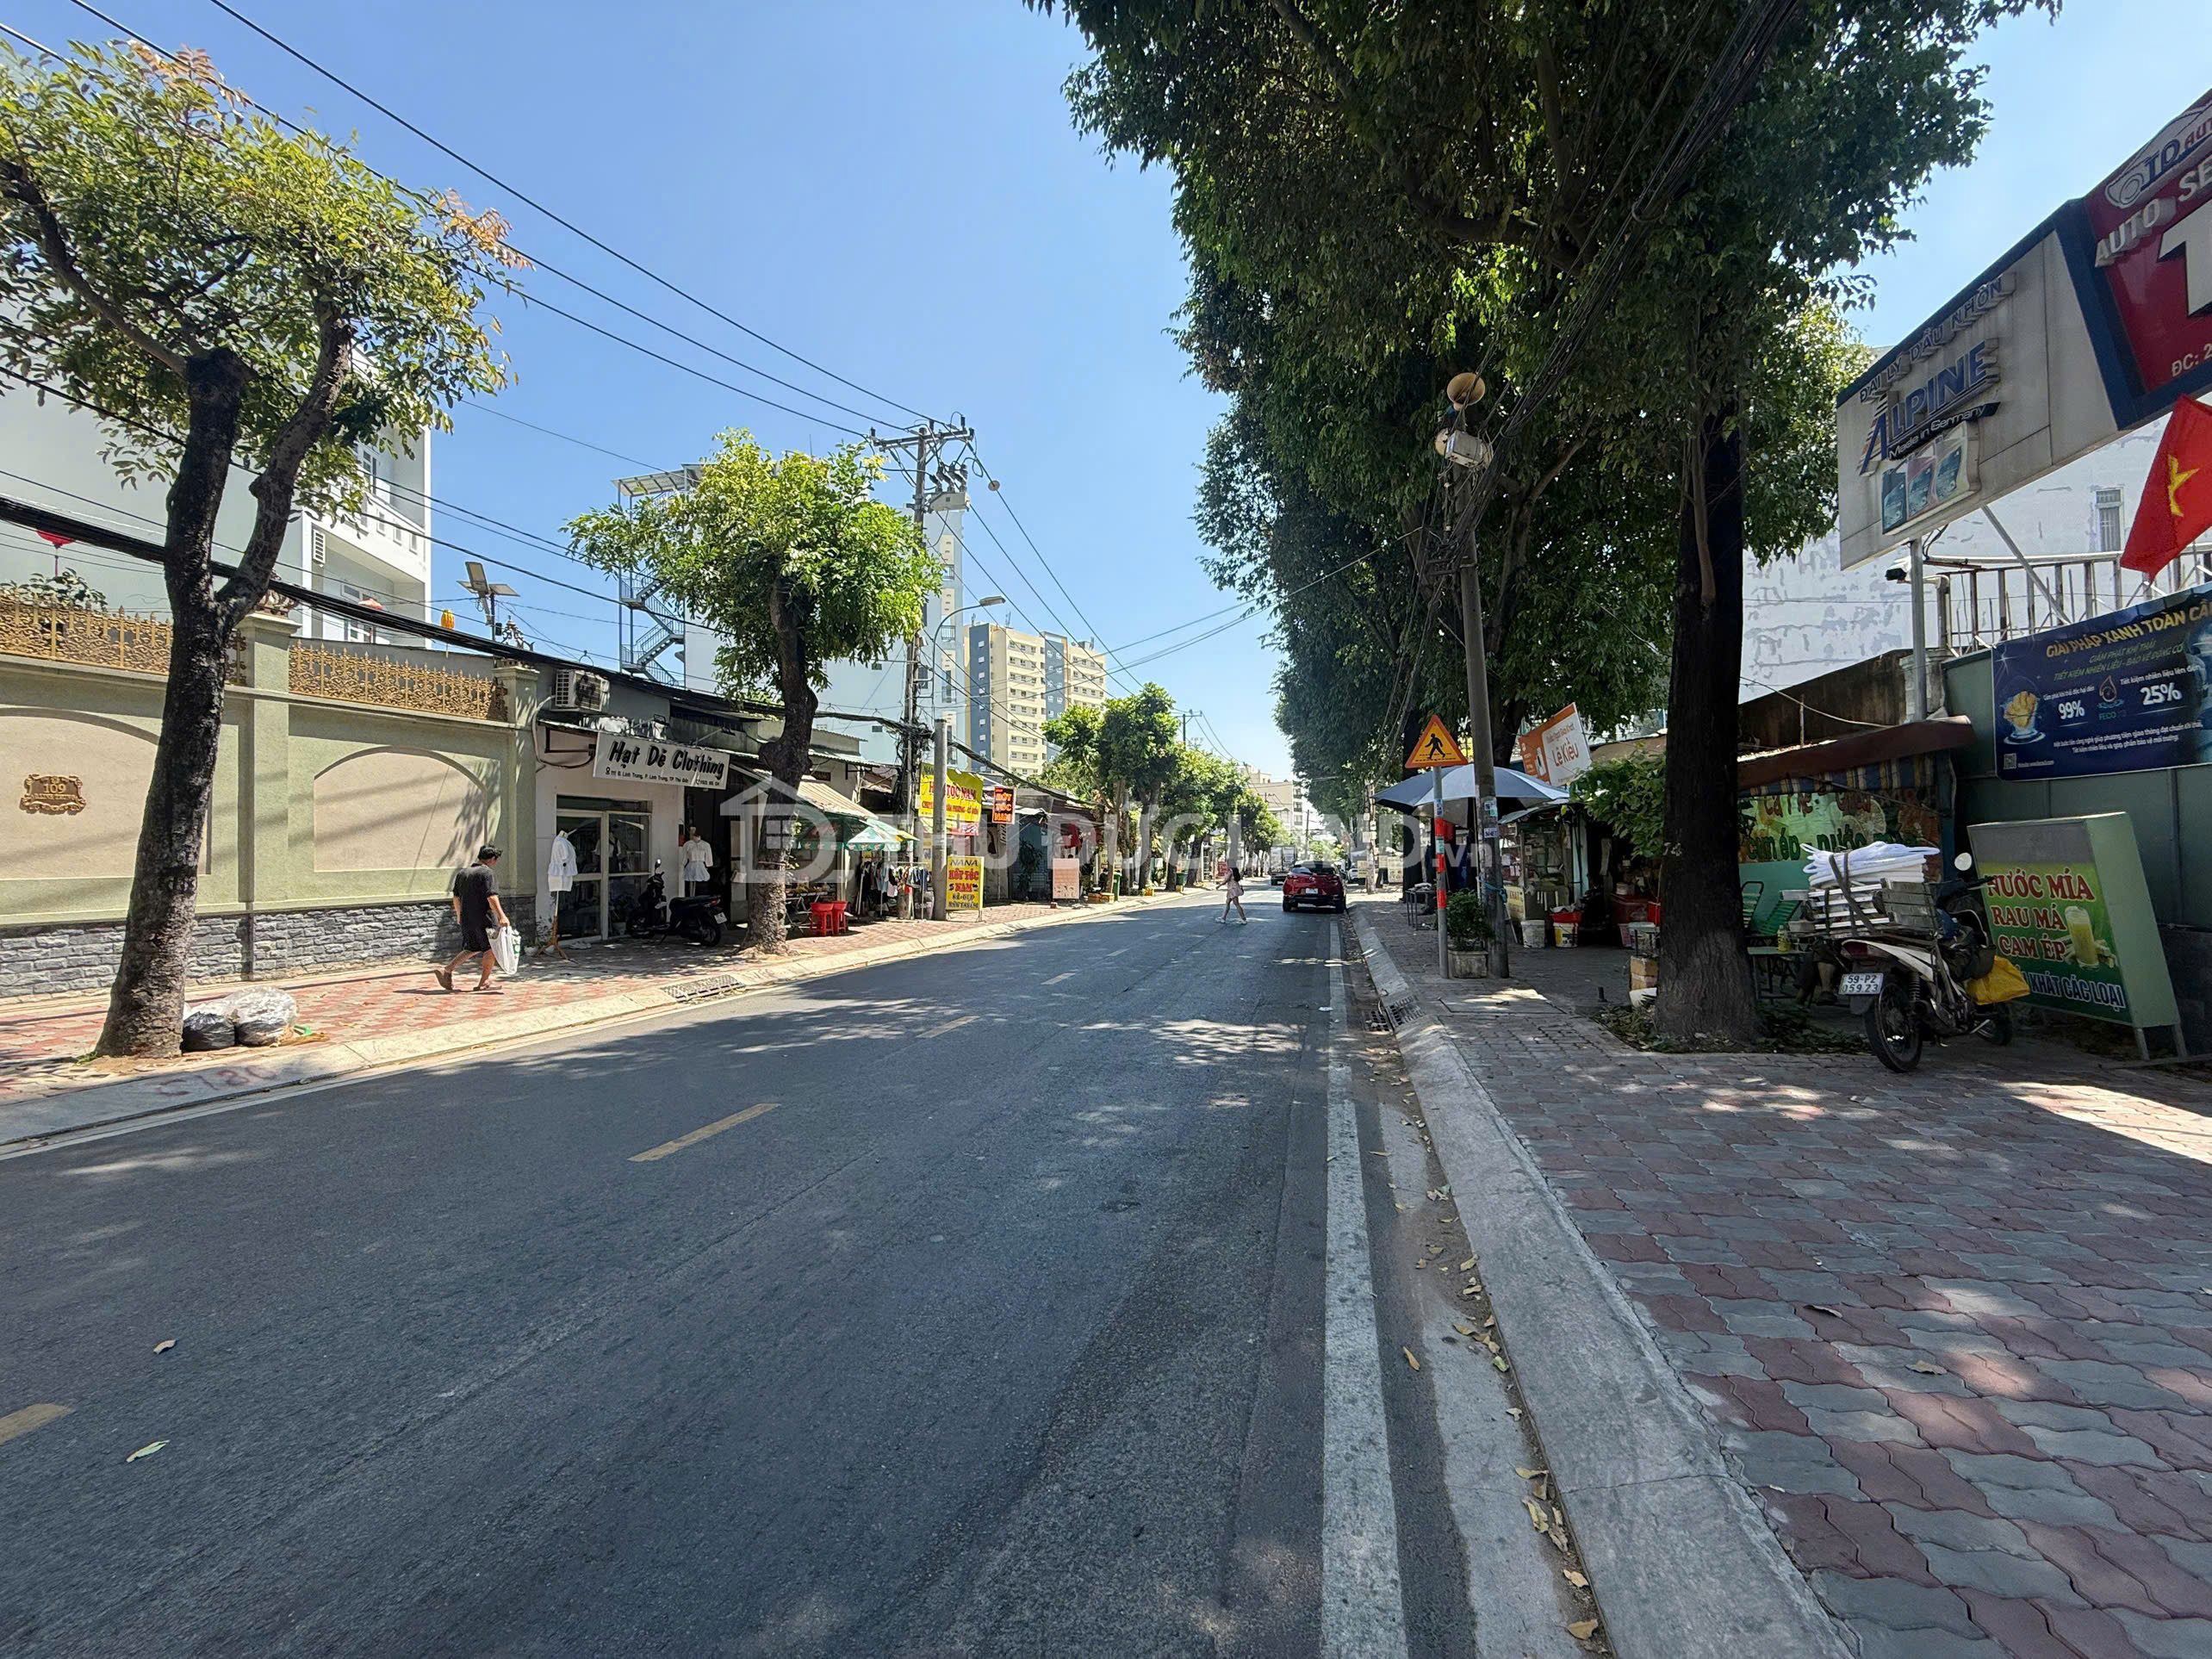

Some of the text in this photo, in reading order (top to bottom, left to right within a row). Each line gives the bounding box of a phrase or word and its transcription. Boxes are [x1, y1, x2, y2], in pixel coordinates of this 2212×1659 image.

[2095, 197, 2161, 268] AUTO
[2172, 353, 2199, 377] ĐC:
[1859, 340, 1986, 475] ALPINE
[1888, 403, 1988, 461] Made in Germany
[2101, 624, 2145, 644] XANH
[2141, 609, 2186, 633] TOÀN
[2140, 682, 2183, 705] 25%
[2058, 699, 2085, 720] 99%
[608, 741, 641, 768] Hạt
[671, 749, 725, 780] Clothing
[43, 783, 67, 794] 109
[954, 882, 973, 892] NAM
[2046, 868, 2095, 901] MÍA
[1991, 904, 2067, 930] RAU MÁ
[1998, 933, 2066, 962] CAM ÉP
[1848, 974, 1878, 984] 59-P2
[2029, 971, 2062, 997] KHÁT
[2061, 974, 2091, 1003] CÁC
[2091, 981, 2127, 1012] LOẠI
